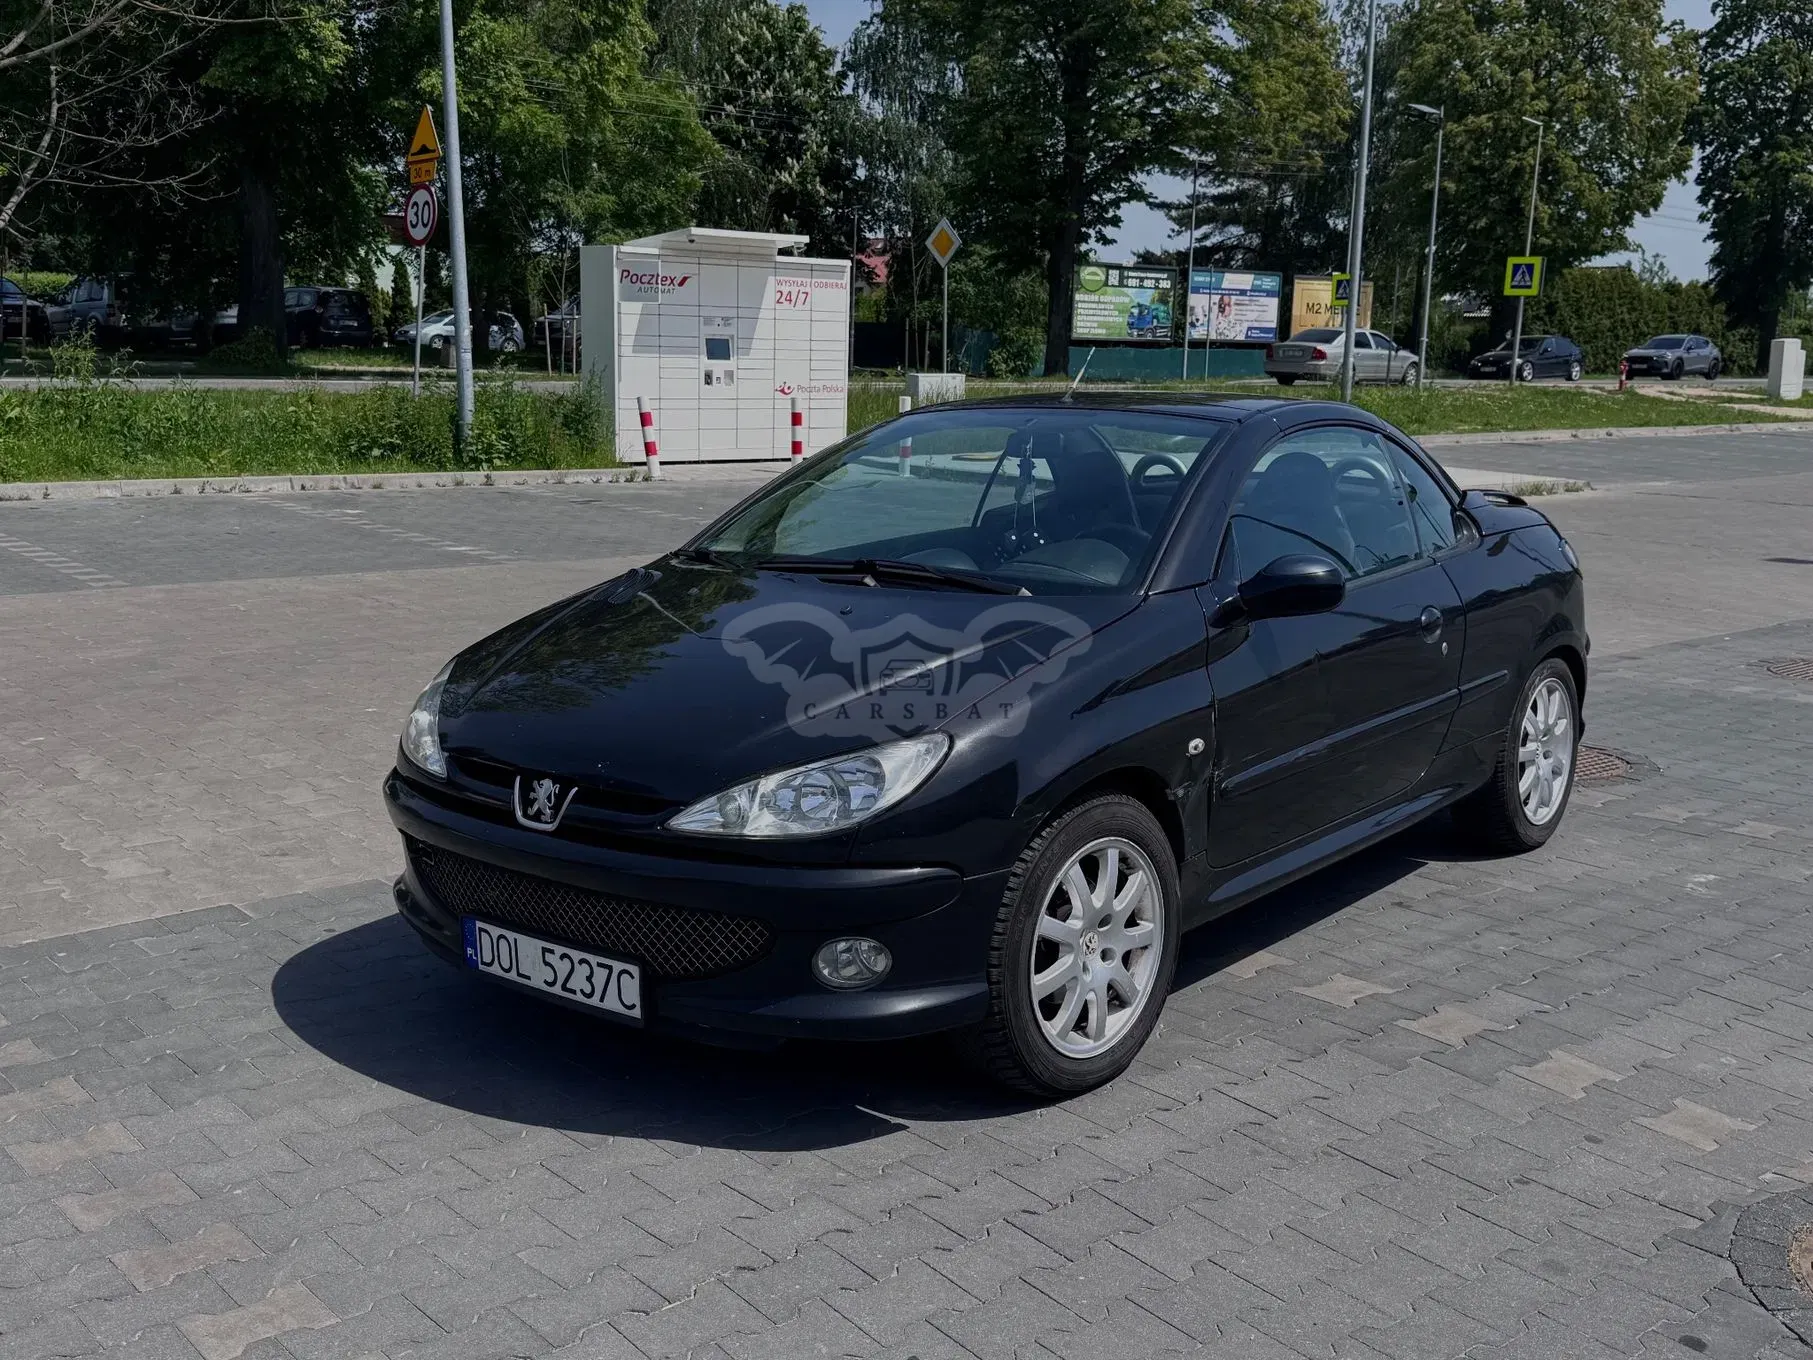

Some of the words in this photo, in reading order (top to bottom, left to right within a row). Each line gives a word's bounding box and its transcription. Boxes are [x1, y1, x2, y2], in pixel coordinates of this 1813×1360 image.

[413, 167, 423, 179] 30
[424, 169, 431, 177] m
[409, 200, 431, 229] 30
[620, 268, 677, 287] Pocztex
[637, 286, 676, 295] AUTOMAT
[813, 281, 848, 290] ODBIERAJ
[776, 289, 809, 308] 24/7
[1306, 302, 1322, 314] M2
[797, 384, 821, 393] Poczta
[822, 384, 844, 393] Polska
[467, 947, 477, 960] PL
[478, 926, 532, 981] DOL
[541, 946, 637, 1010] 5237C
